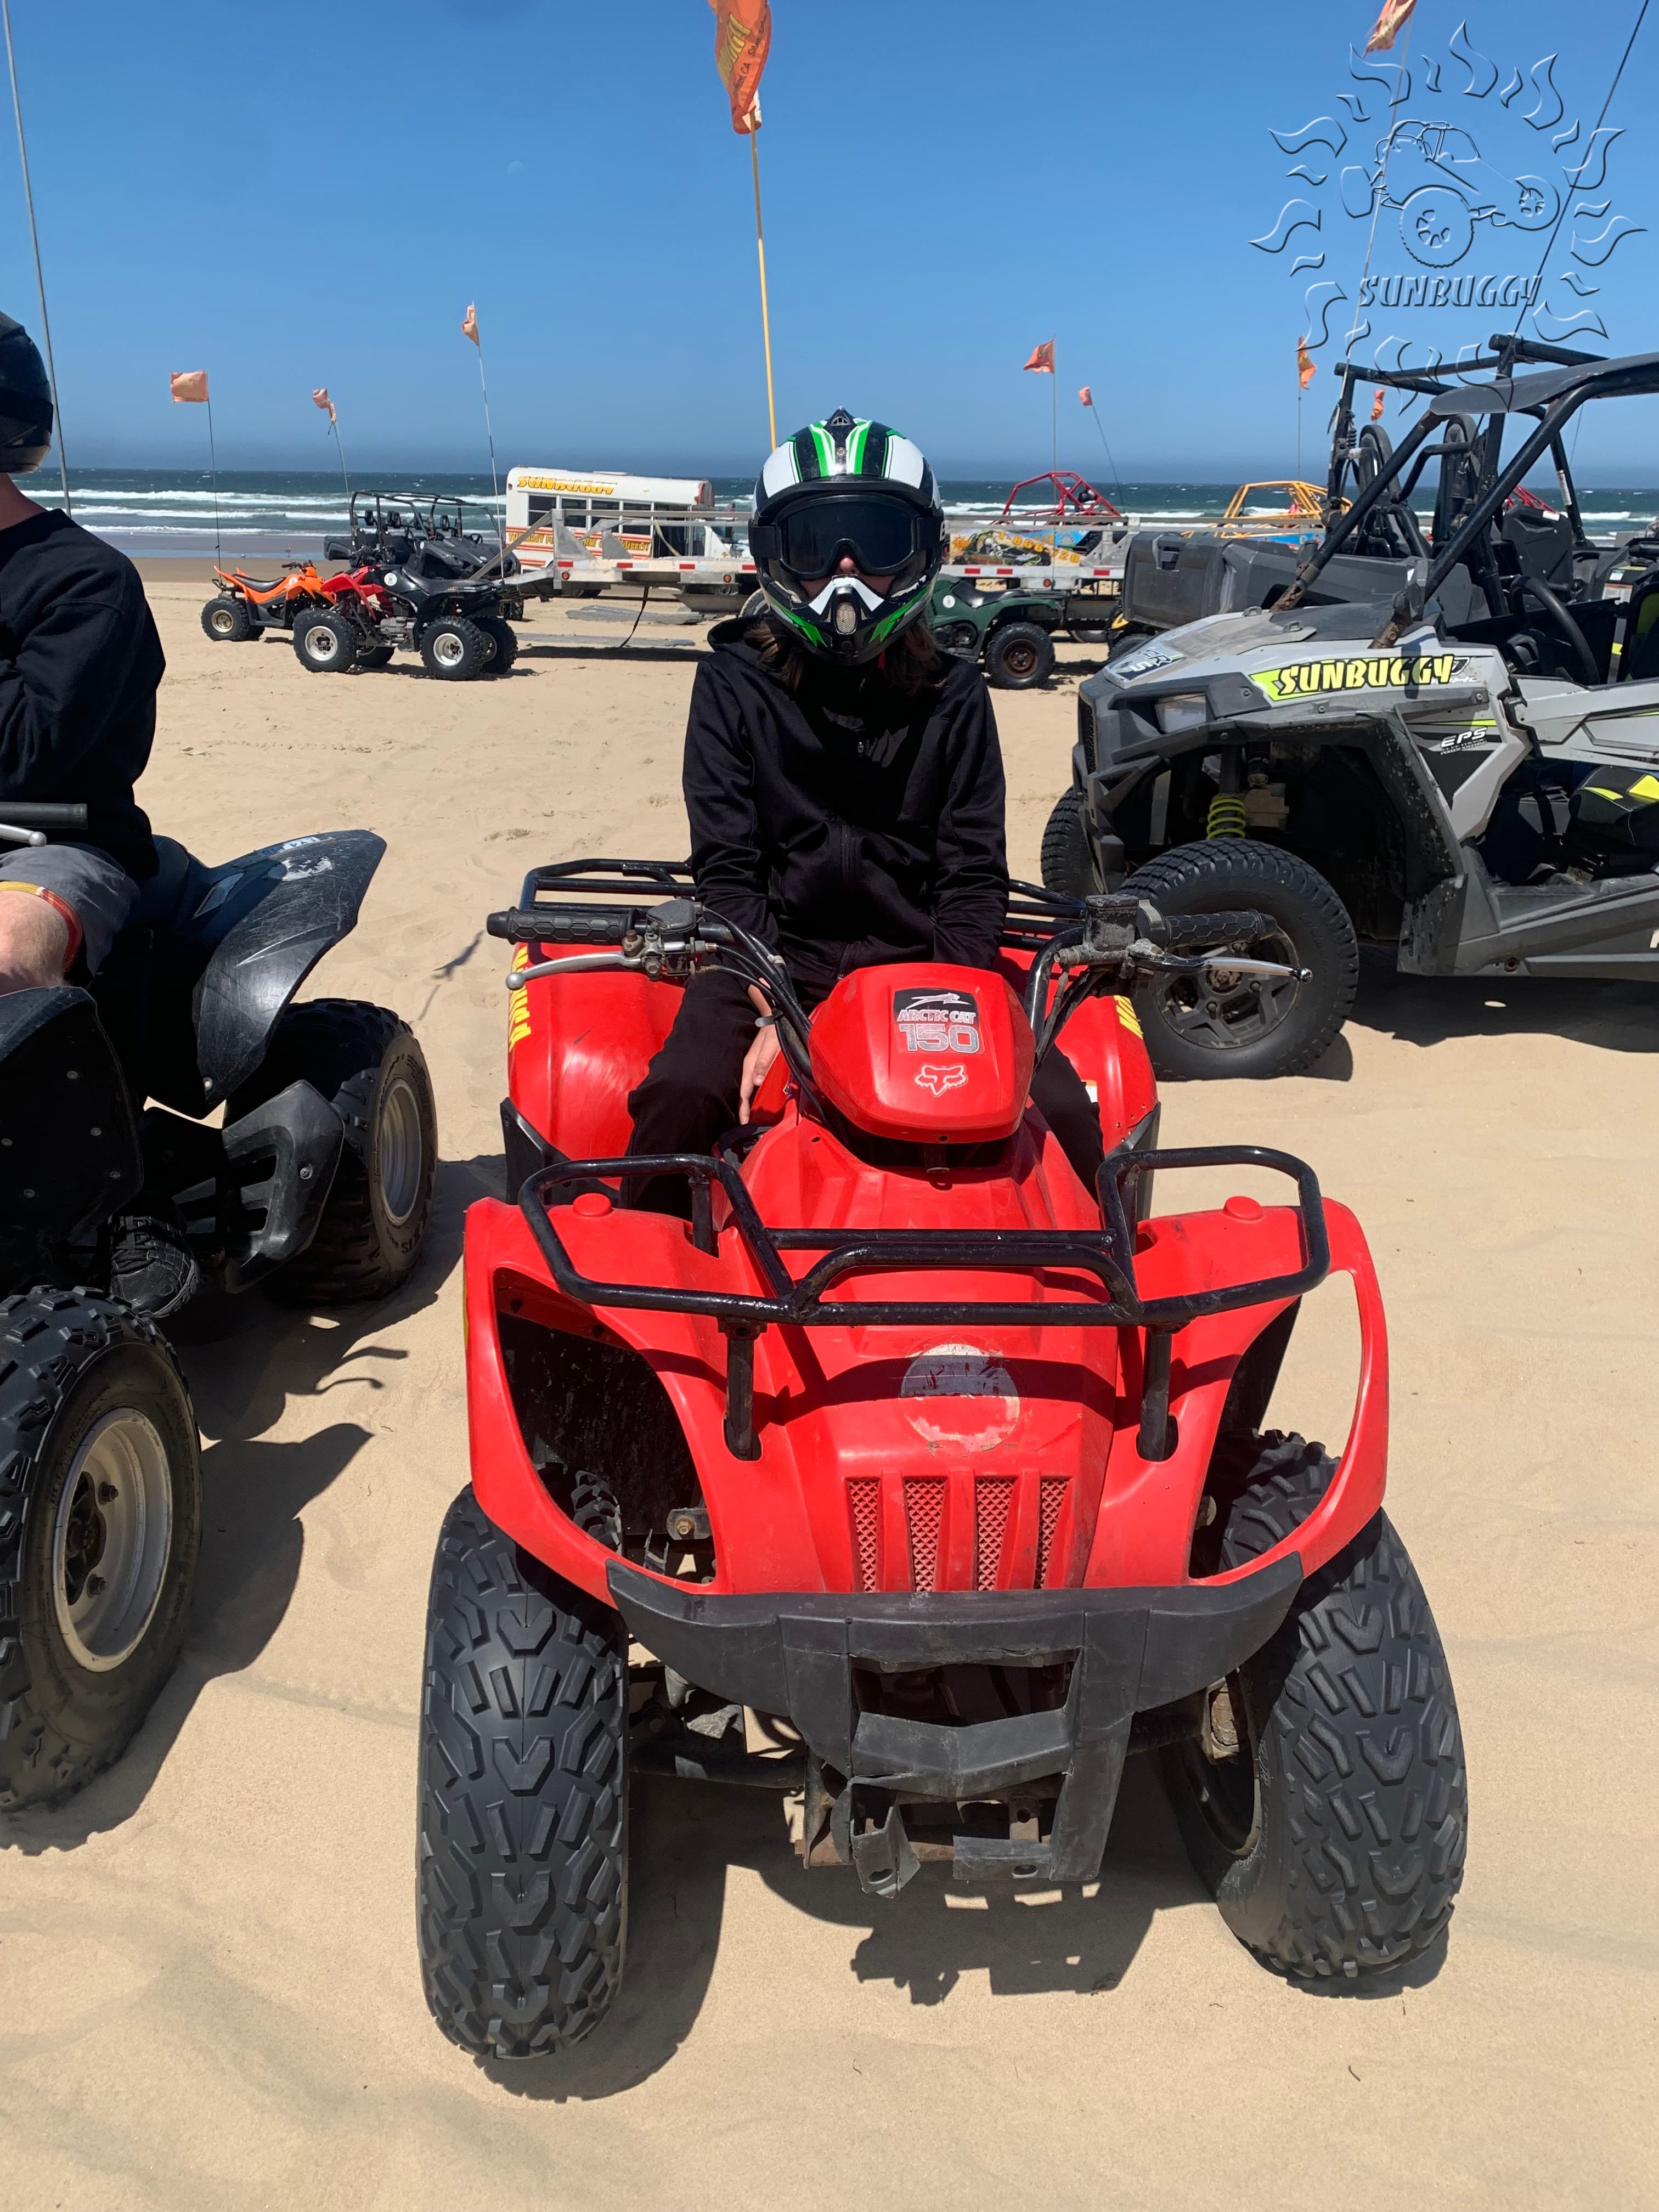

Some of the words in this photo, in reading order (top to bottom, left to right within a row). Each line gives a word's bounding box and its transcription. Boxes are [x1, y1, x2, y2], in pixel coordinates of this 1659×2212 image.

[517, 476, 618, 495] SUNBUGGY
[1278, 654, 1454, 696] SUNBUGGY
[1441, 727, 1488, 748] EPS
[897, 1009, 949, 1022] ARCTIC
[949, 1010, 977, 1024] CAT
[899, 1023, 980, 1053] 150
